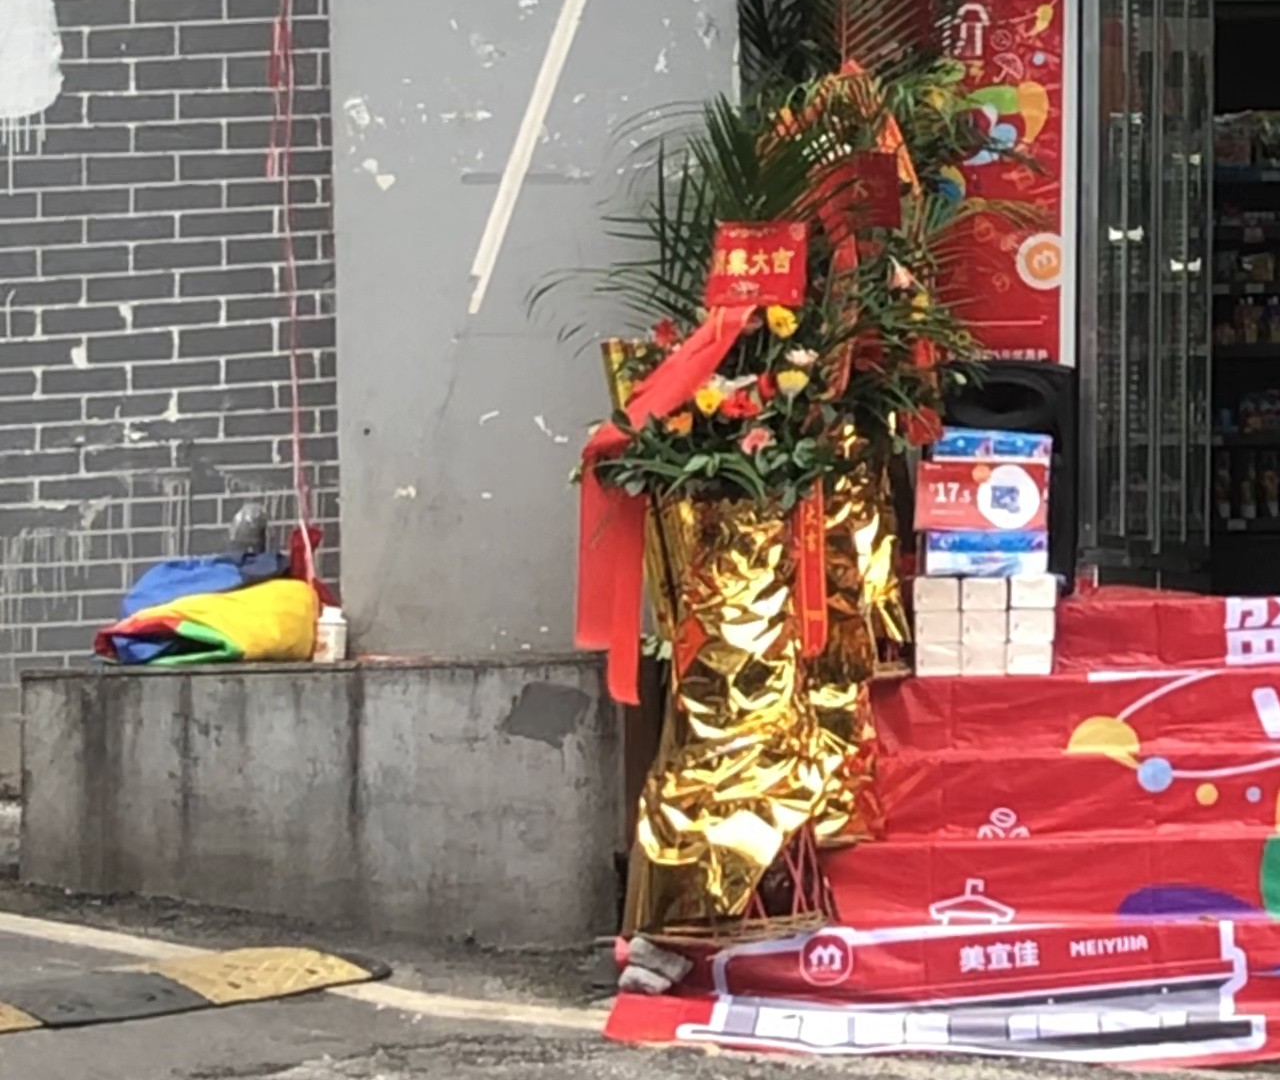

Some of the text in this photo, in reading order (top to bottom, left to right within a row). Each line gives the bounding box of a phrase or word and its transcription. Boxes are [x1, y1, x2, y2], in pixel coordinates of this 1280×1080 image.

[959, 941, 1040, 973] 美宜佳
[1069, 933, 1149, 959] MEIYIJIA
